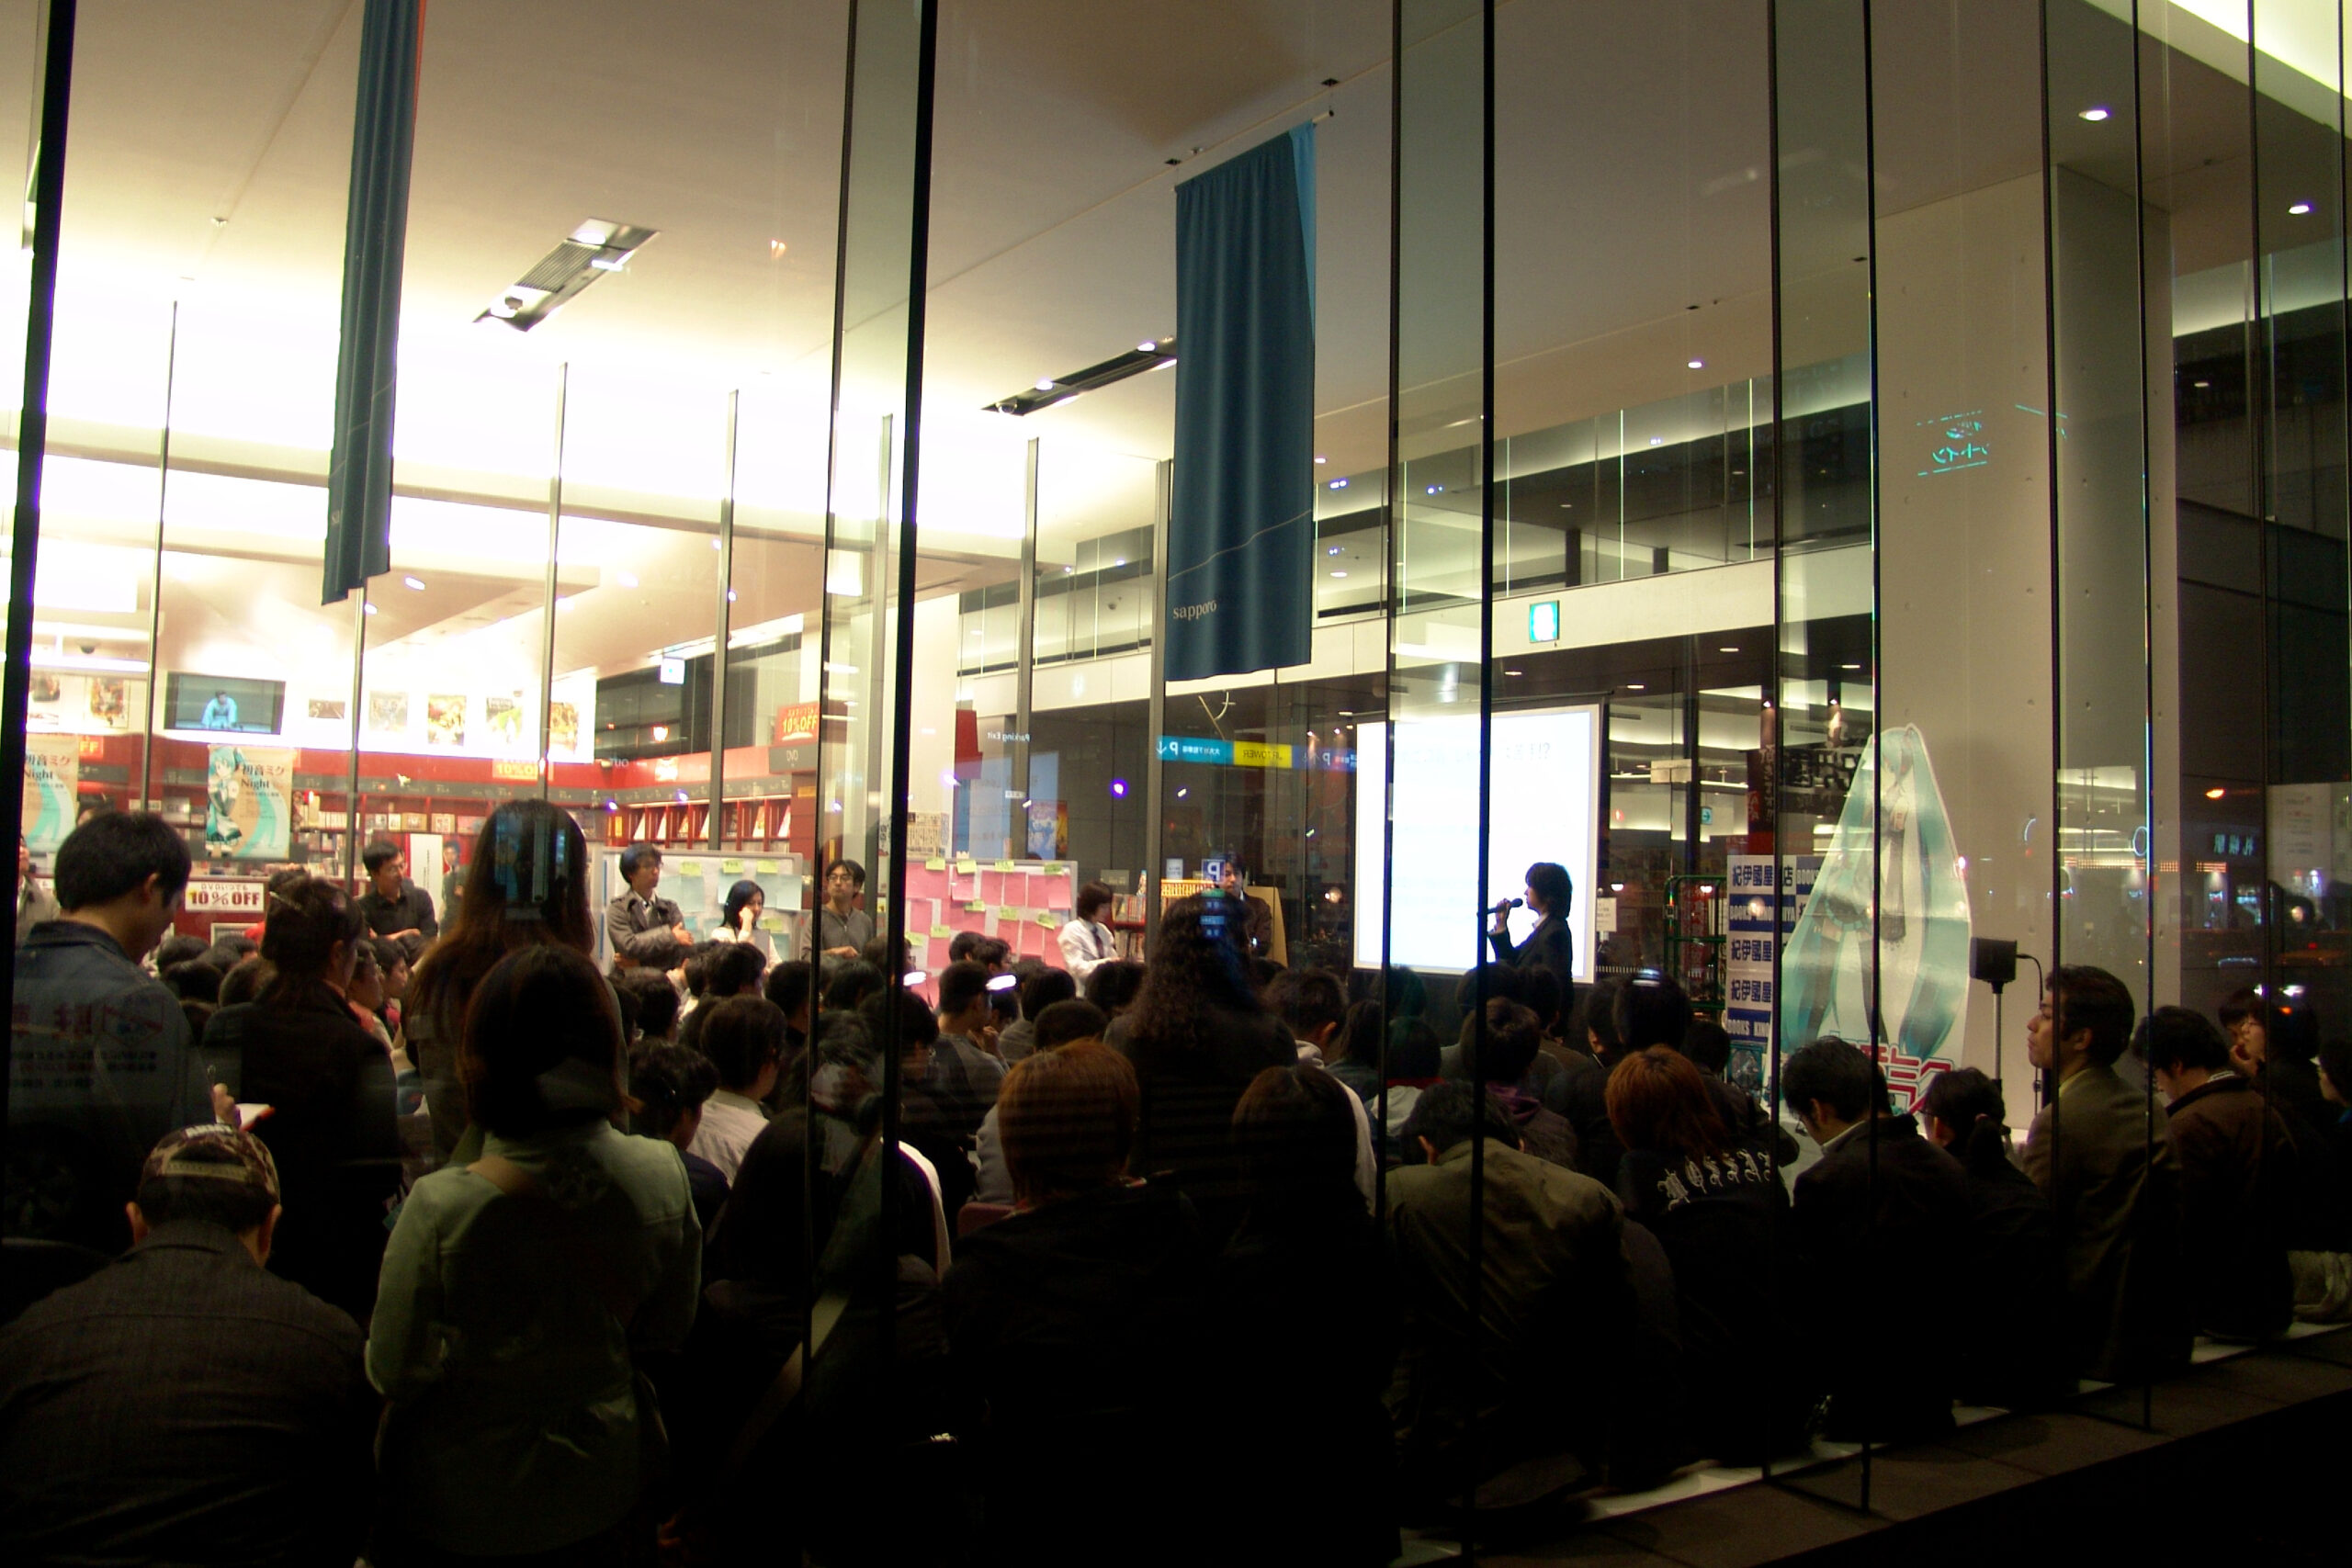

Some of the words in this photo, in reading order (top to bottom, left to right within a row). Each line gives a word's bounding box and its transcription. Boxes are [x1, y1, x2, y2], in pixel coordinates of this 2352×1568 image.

[1172, 599, 1217, 621] sapporo
[241, 779, 269, 790] Night
[1732, 864, 1793, 887] 紀伊國屋店
